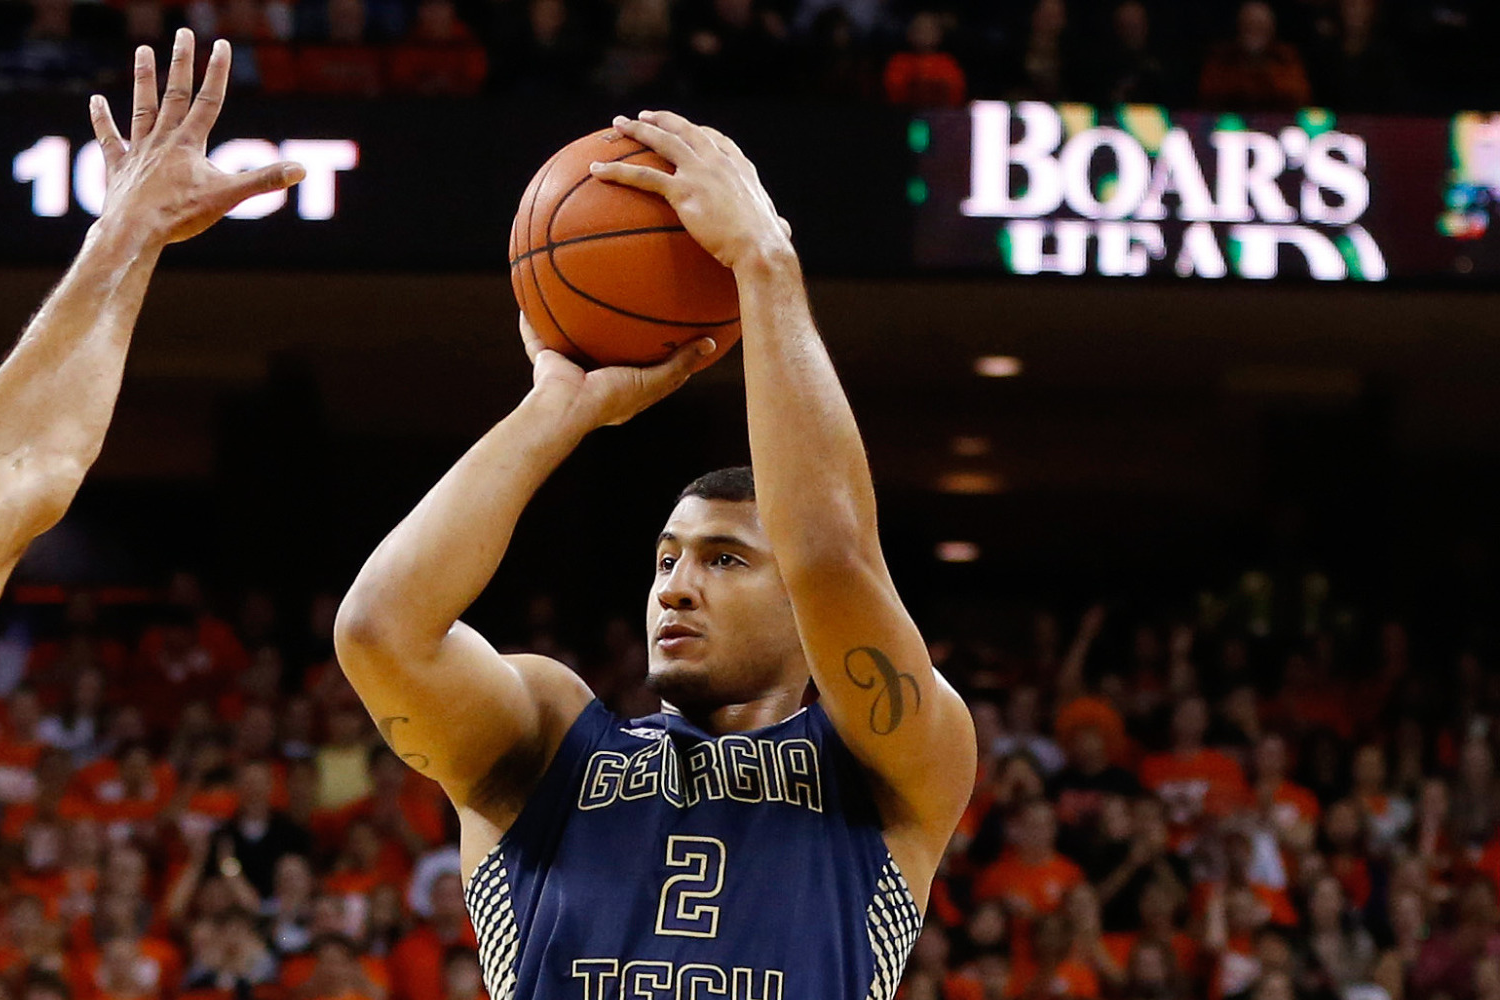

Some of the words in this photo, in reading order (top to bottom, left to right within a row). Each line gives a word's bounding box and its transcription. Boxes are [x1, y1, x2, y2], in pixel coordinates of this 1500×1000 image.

[961, 100, 1370, 226] BOAR'S
[577, 734, 823, 813] GEORGIA
[655, 835, 727, 938] 2
